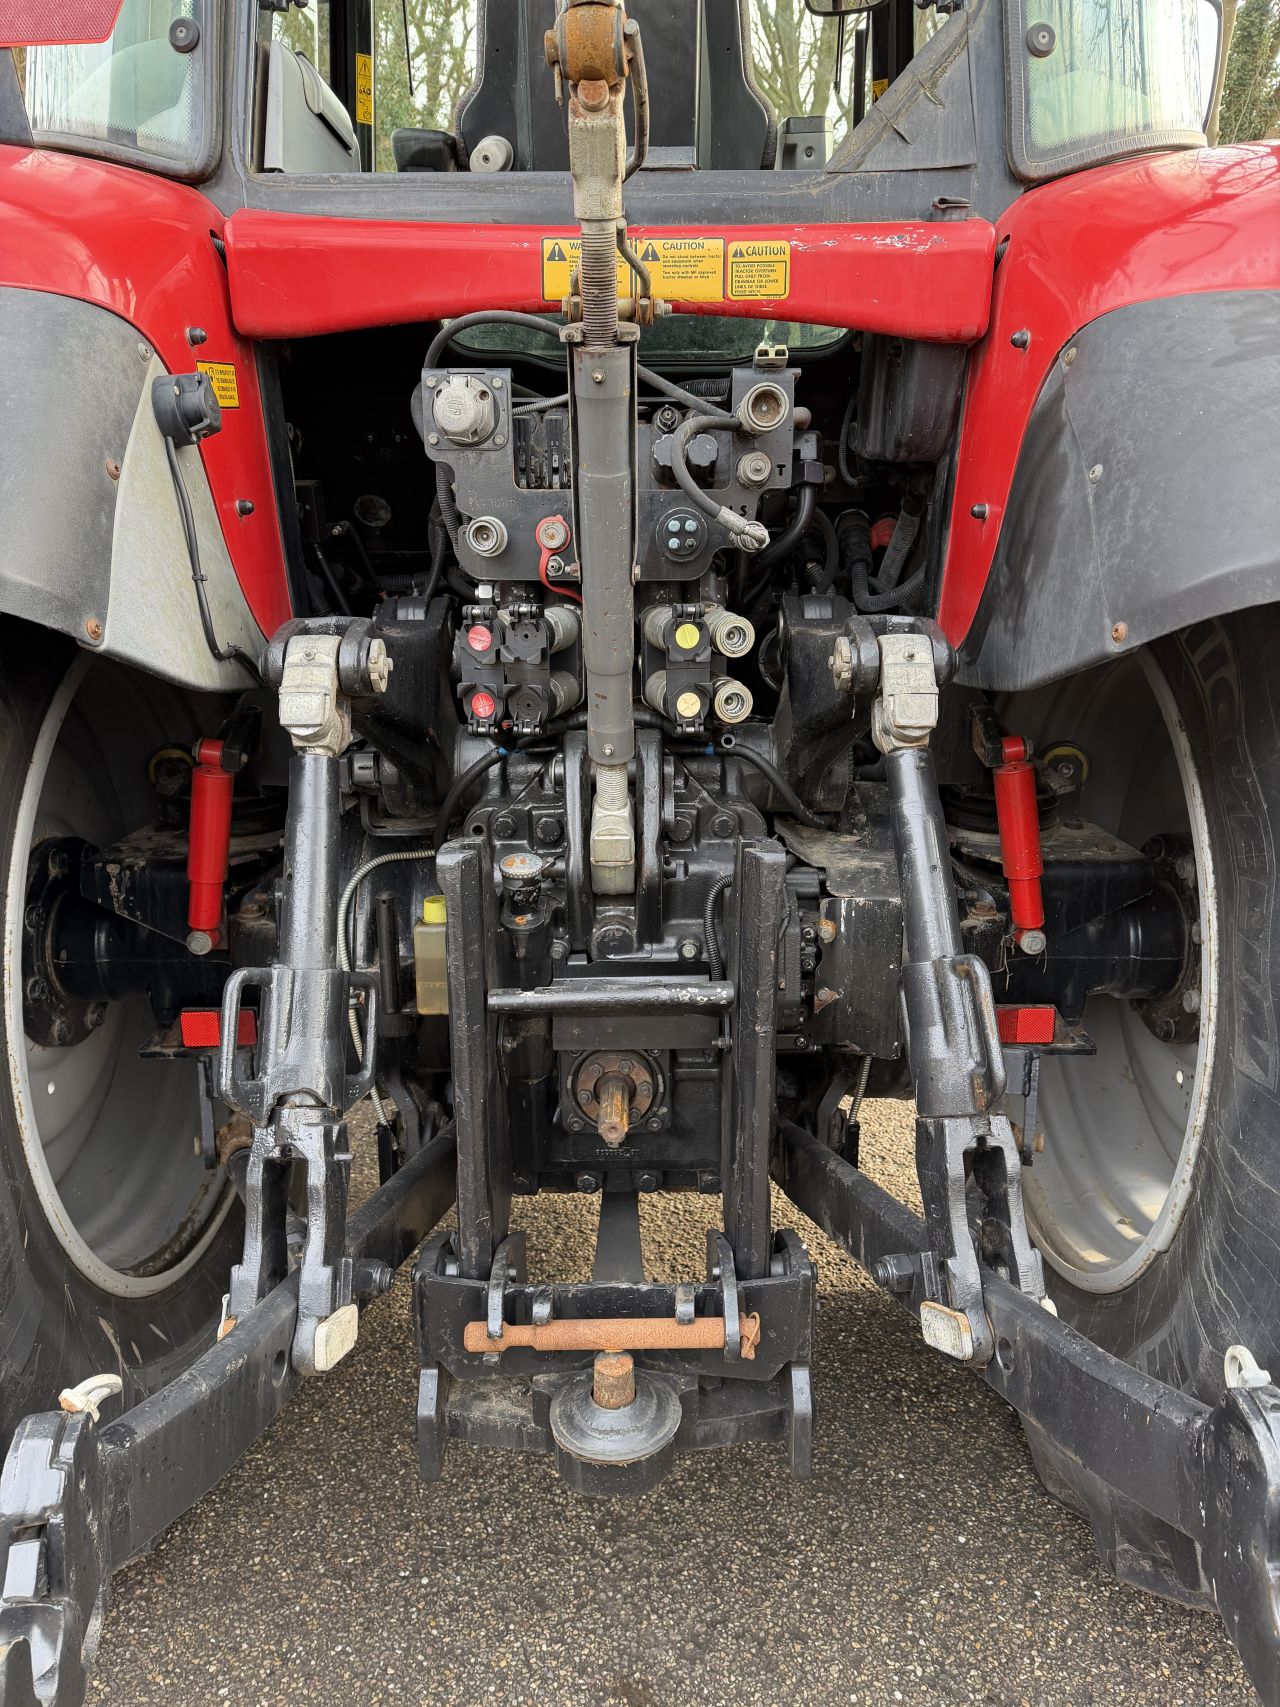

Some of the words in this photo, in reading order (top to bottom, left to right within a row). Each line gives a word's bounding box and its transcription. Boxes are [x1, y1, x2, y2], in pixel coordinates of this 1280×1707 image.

[663, 242, 704, 250] CAUTION
[746, 245, 785, 256] CAUTION
[776, 464, 786, 476] T
